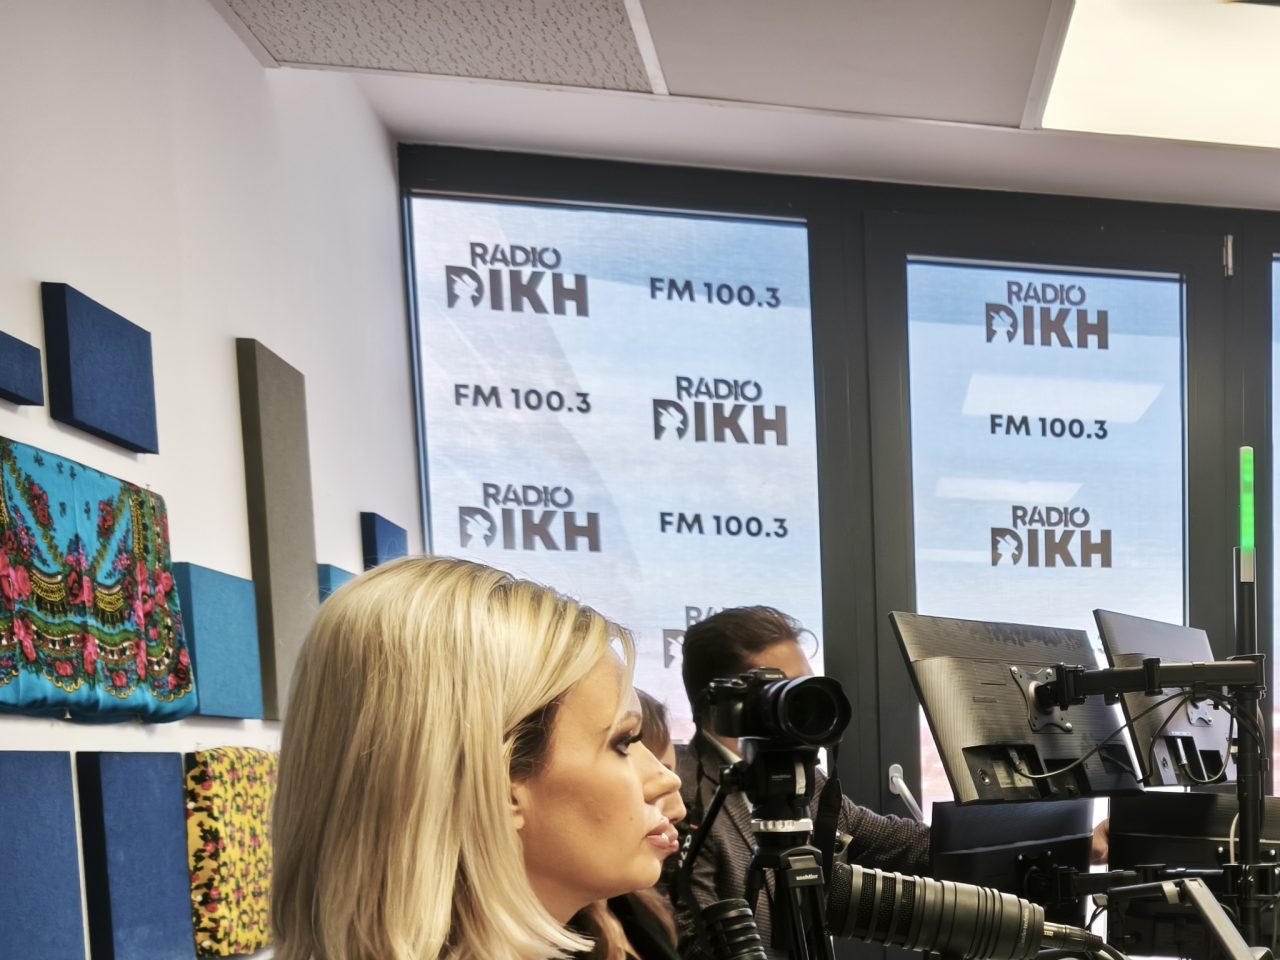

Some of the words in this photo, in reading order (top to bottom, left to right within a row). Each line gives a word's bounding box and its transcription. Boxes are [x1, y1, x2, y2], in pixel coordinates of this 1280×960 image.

[470, 242, 562, 270] RADIO
[649, 277, 696, 302] FM
[705, 283, 781, 309] 100.3
[1006, 280, 1087, 306] RADIO
[453, 384, 501, 410] FM
[511, 388, 592, 414] 100.3
[676, 376, 763, 403] RADIO
[990, 414, 1031, 436] FM
[1038, 417, 1109, 440] 100.3
[482, 482, 574, 509] RADIO
[659, 512, 704, 537] FM
[712, 515, 789, 540] 100.3
[1011, 505, 1091, 529] RADIO
